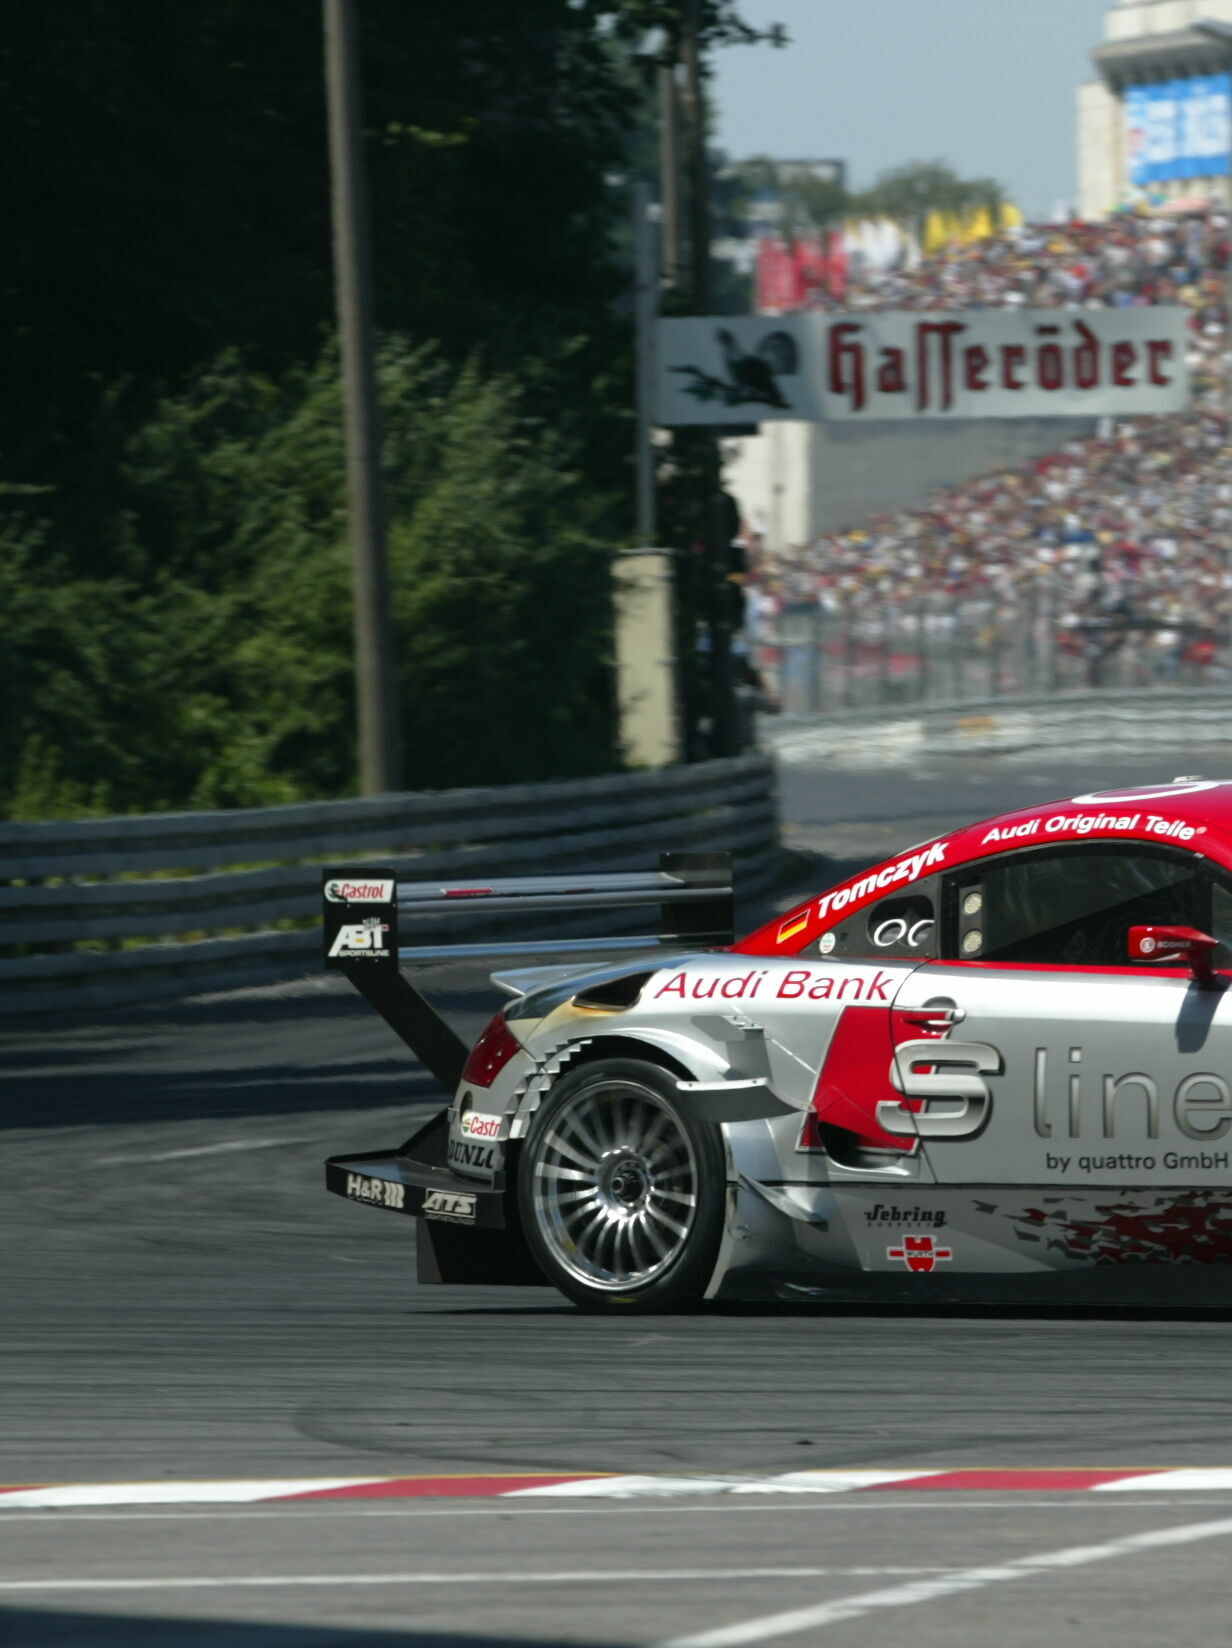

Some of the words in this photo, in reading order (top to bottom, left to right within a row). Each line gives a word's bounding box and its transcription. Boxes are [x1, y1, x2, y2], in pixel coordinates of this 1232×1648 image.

[981, 819, 1041, 845] Audi
[1045, 813, 1140, 834] Original
[1146, 816, 1196, 840] Teile
[342, 883, 385, 899] Castrol
[817, 841, 949, 919] Tomczyk
[328, 924, 388, 957] ABT
[653, 970, 768, 1000] Audi
[776, 970, 894, 1001] Bank
[1034, 1047, 1232, 1141] line
[470, 1116, 500, 1137] Castr
[1046, 1153, 1070, 1173] by
[1078, 1154, 1156, 1174] quattro
[1163, 1152, 1229, 1169] GmbH
[347, 1173, 383, 1201] H&R
[421, 1192, 477, 1214] ATS
[864, 1204, 947, 1229] Sebring
